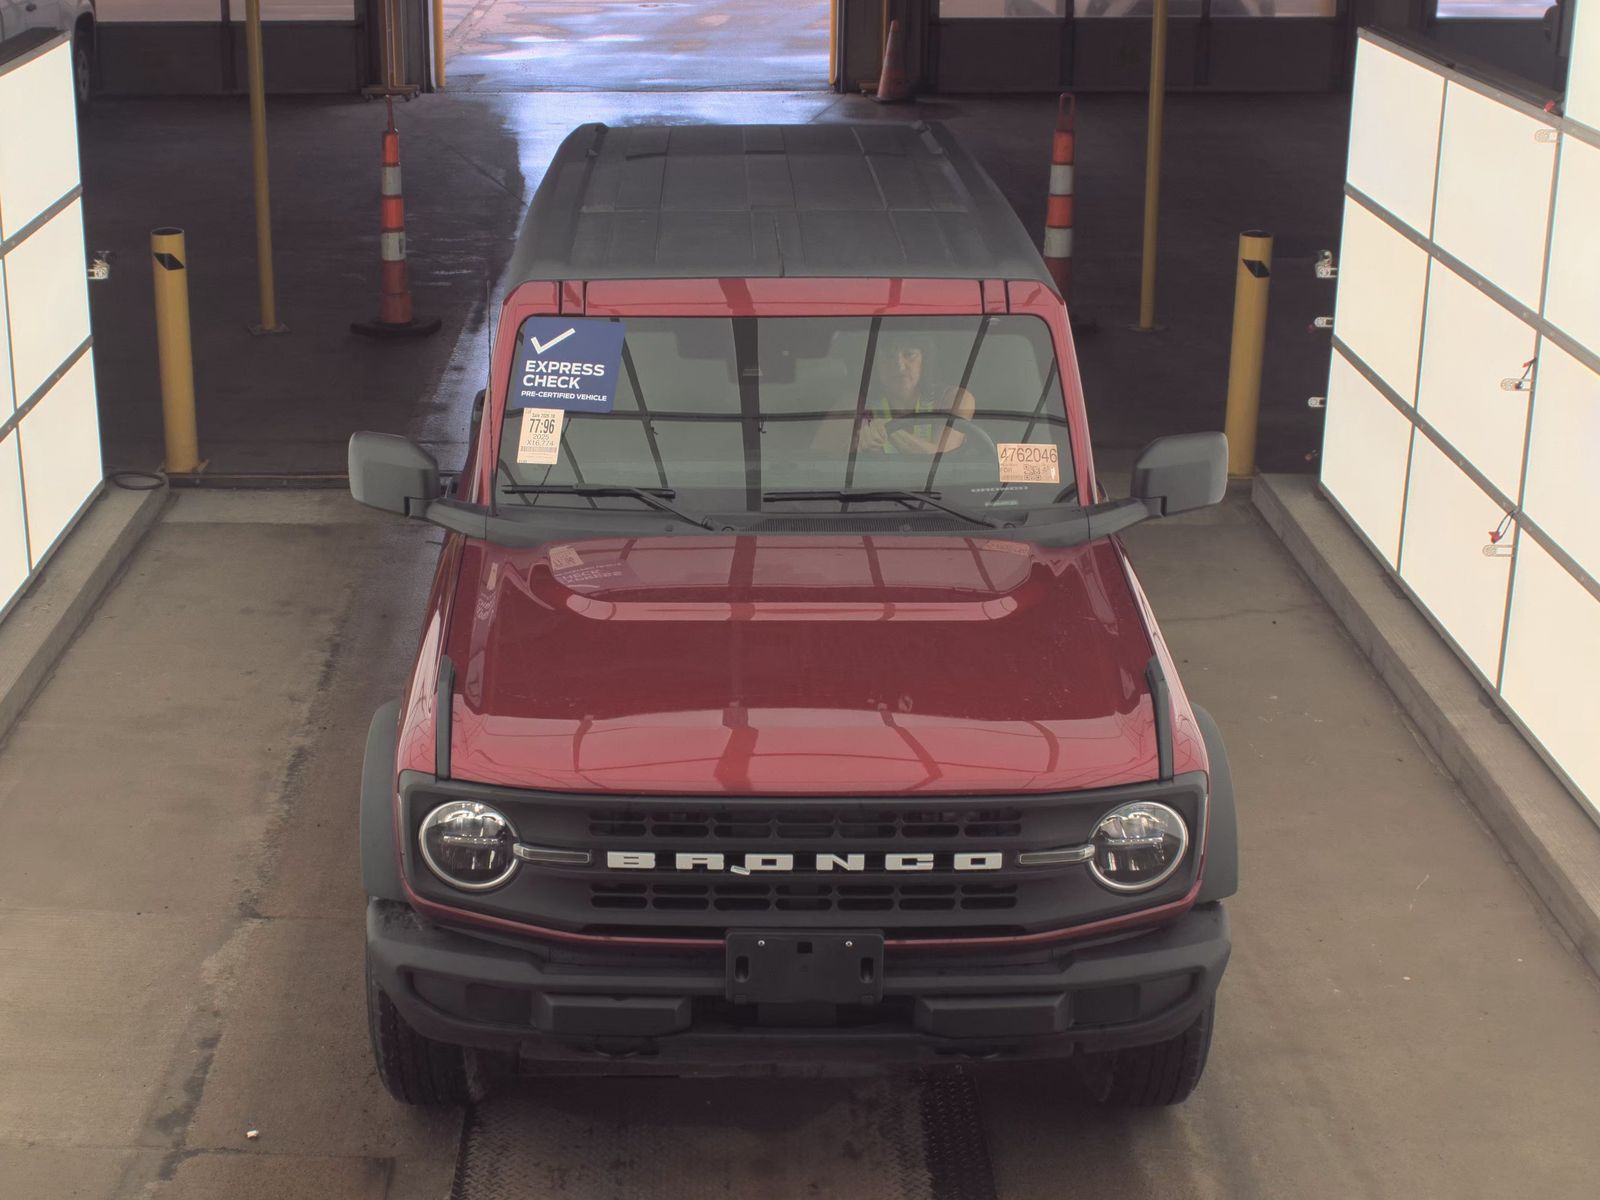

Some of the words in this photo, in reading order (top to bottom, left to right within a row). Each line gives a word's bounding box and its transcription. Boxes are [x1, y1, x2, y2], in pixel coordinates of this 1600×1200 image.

[525, 360, 605, 376] EXPRESS
[523, 374, 580, 389] CHECK
[521, 391, 575, 399] PRE-CERTIFIED
[576, 393, 607, 401] VEHICLE
[529, 418, 555, 434] 77:96
[1000, 448, 1057, 463] 4762046
[607, 851, 1003, 871] BRONCO
